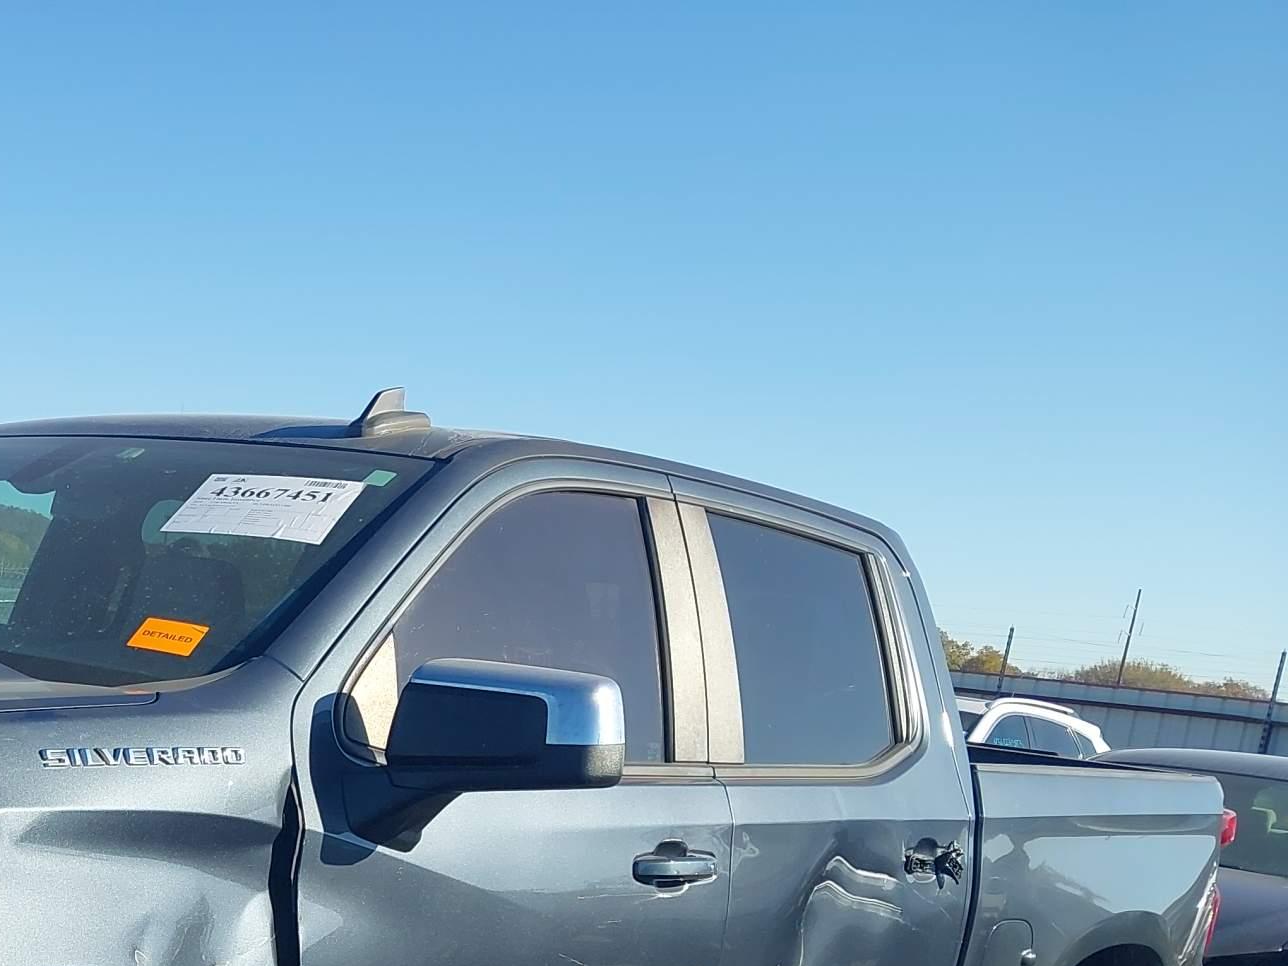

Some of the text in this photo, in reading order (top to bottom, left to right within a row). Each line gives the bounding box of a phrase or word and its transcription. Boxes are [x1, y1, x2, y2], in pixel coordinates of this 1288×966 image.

[209, 485, 336, 504] 43667451
[142, 629, 193, 643] DETAILED
[38, 746, 247, 768] SILVERADO
